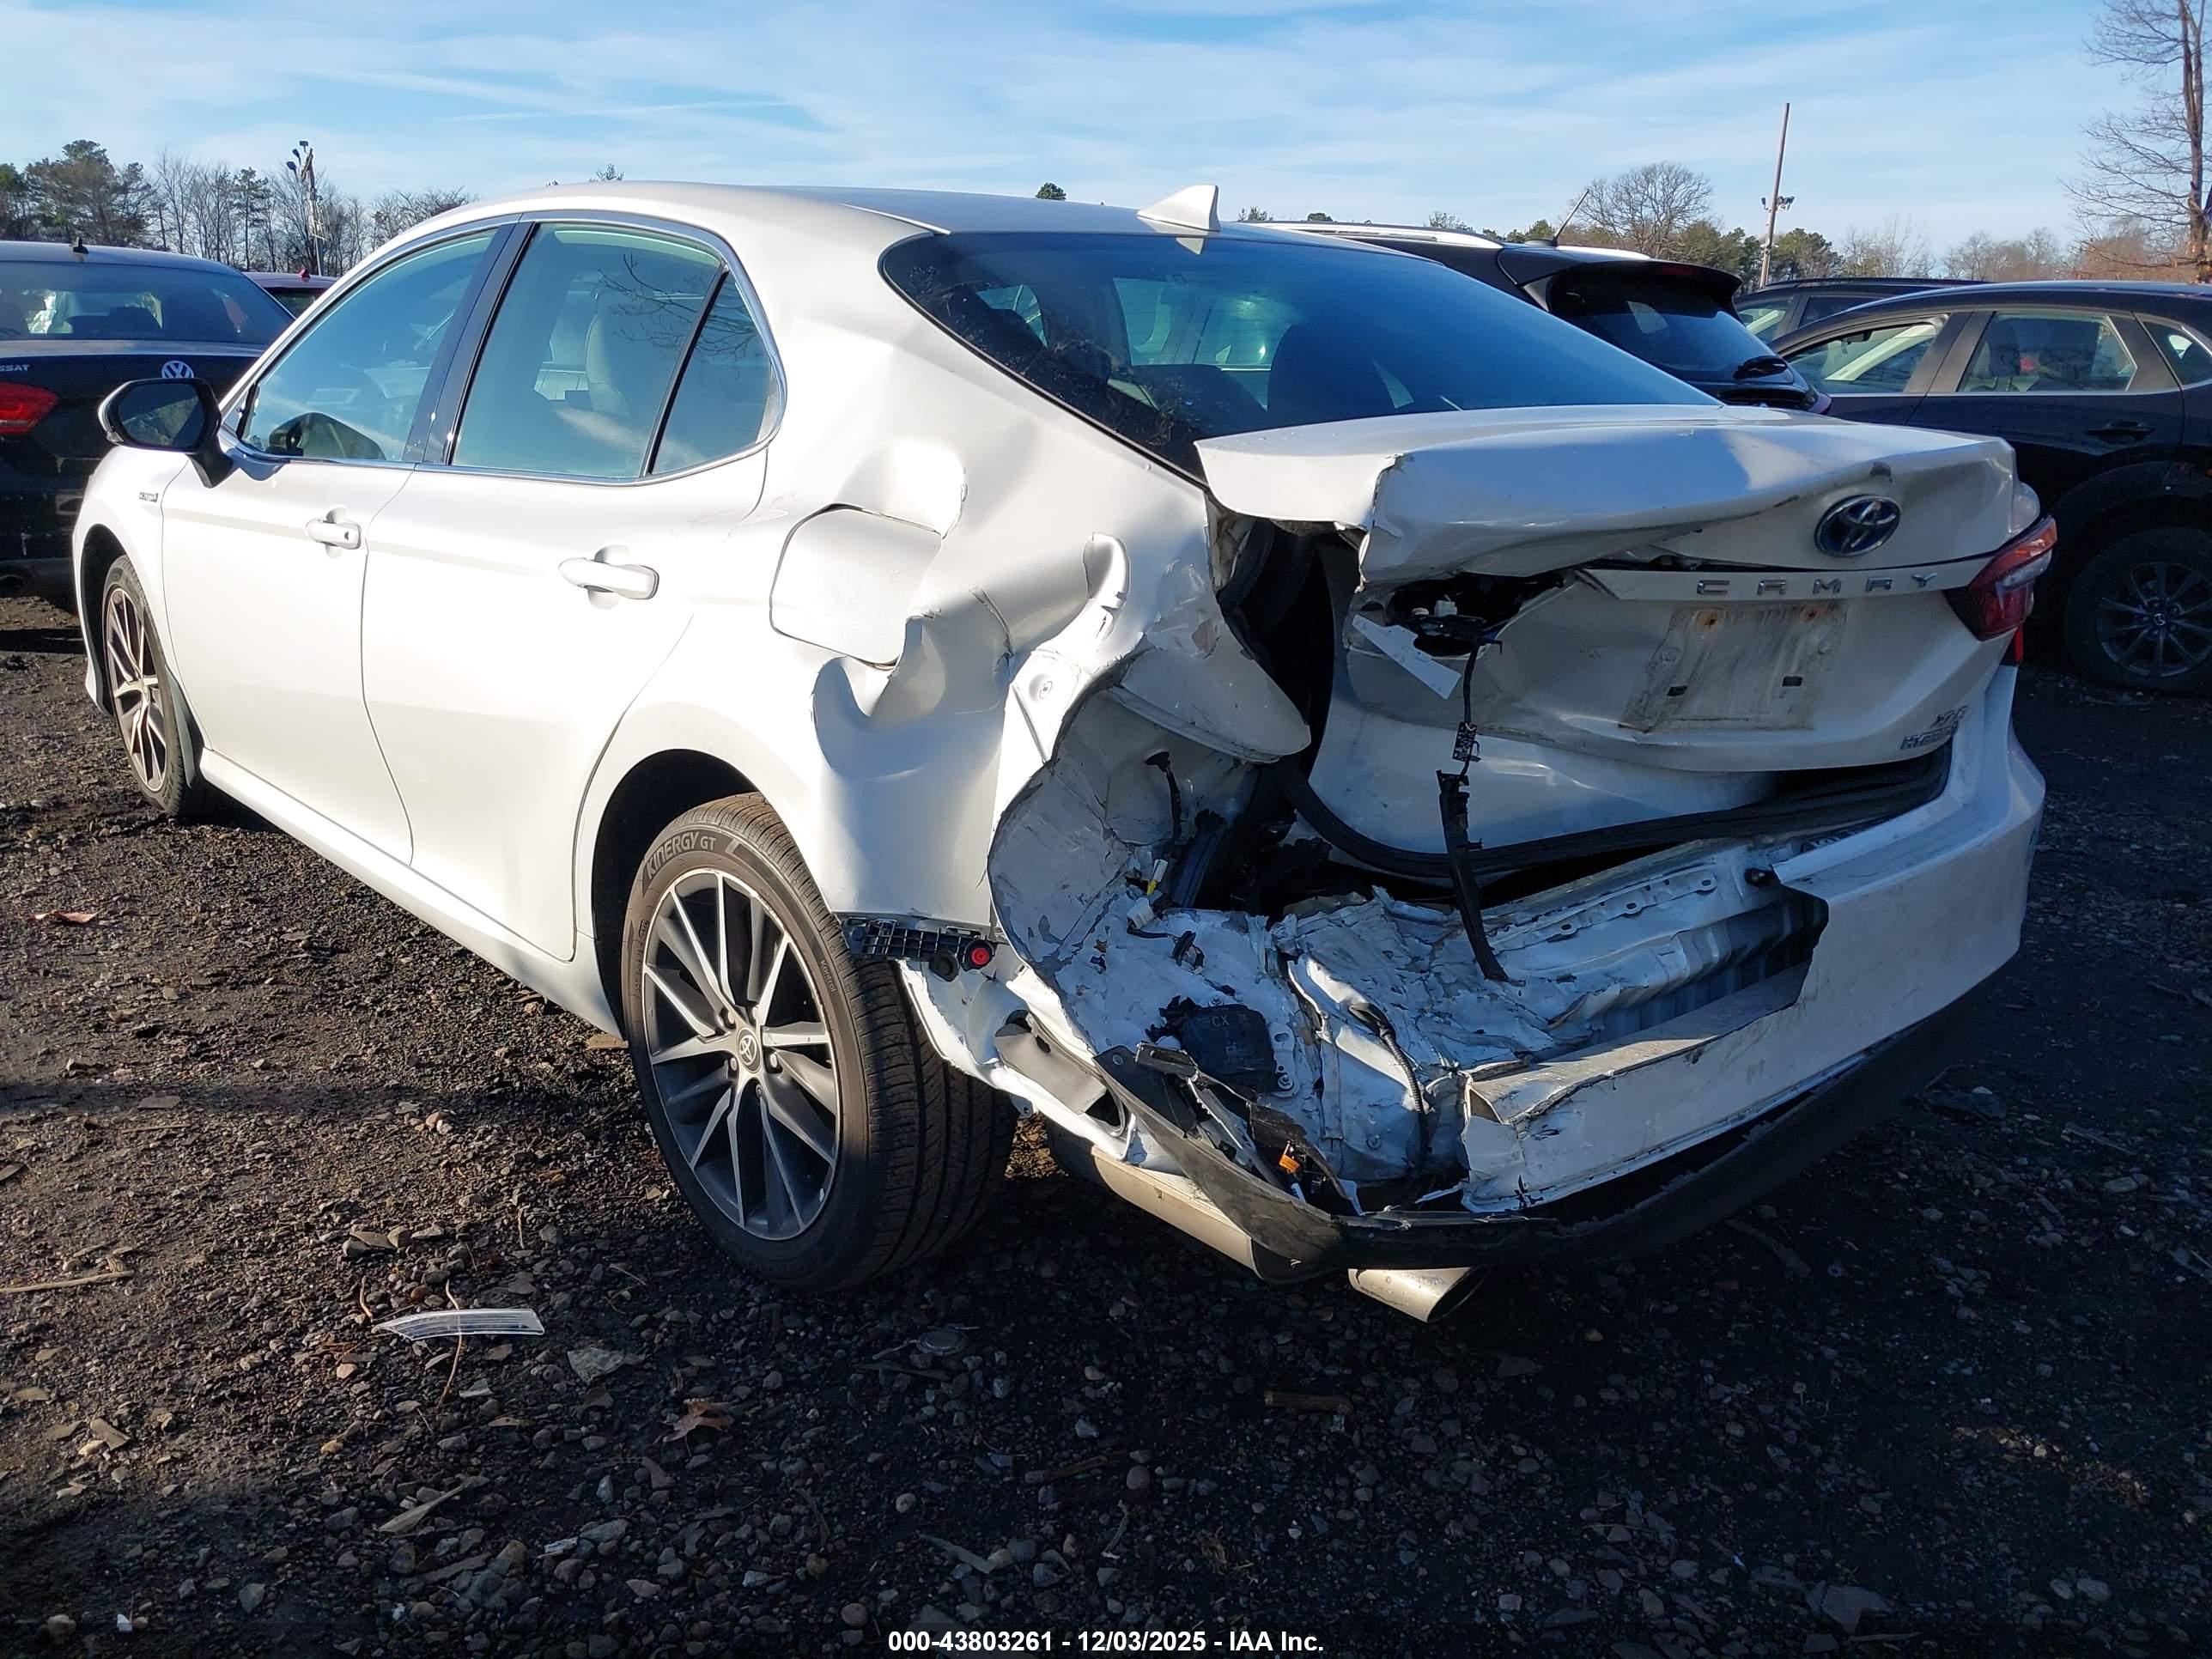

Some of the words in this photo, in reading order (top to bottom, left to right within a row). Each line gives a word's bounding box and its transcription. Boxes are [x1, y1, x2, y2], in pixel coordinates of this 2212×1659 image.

[1697, 573, 1938, 595] CAMRY
[646, 831, 701, 880] KINERGY
[700, 836, 717, 851] GT
